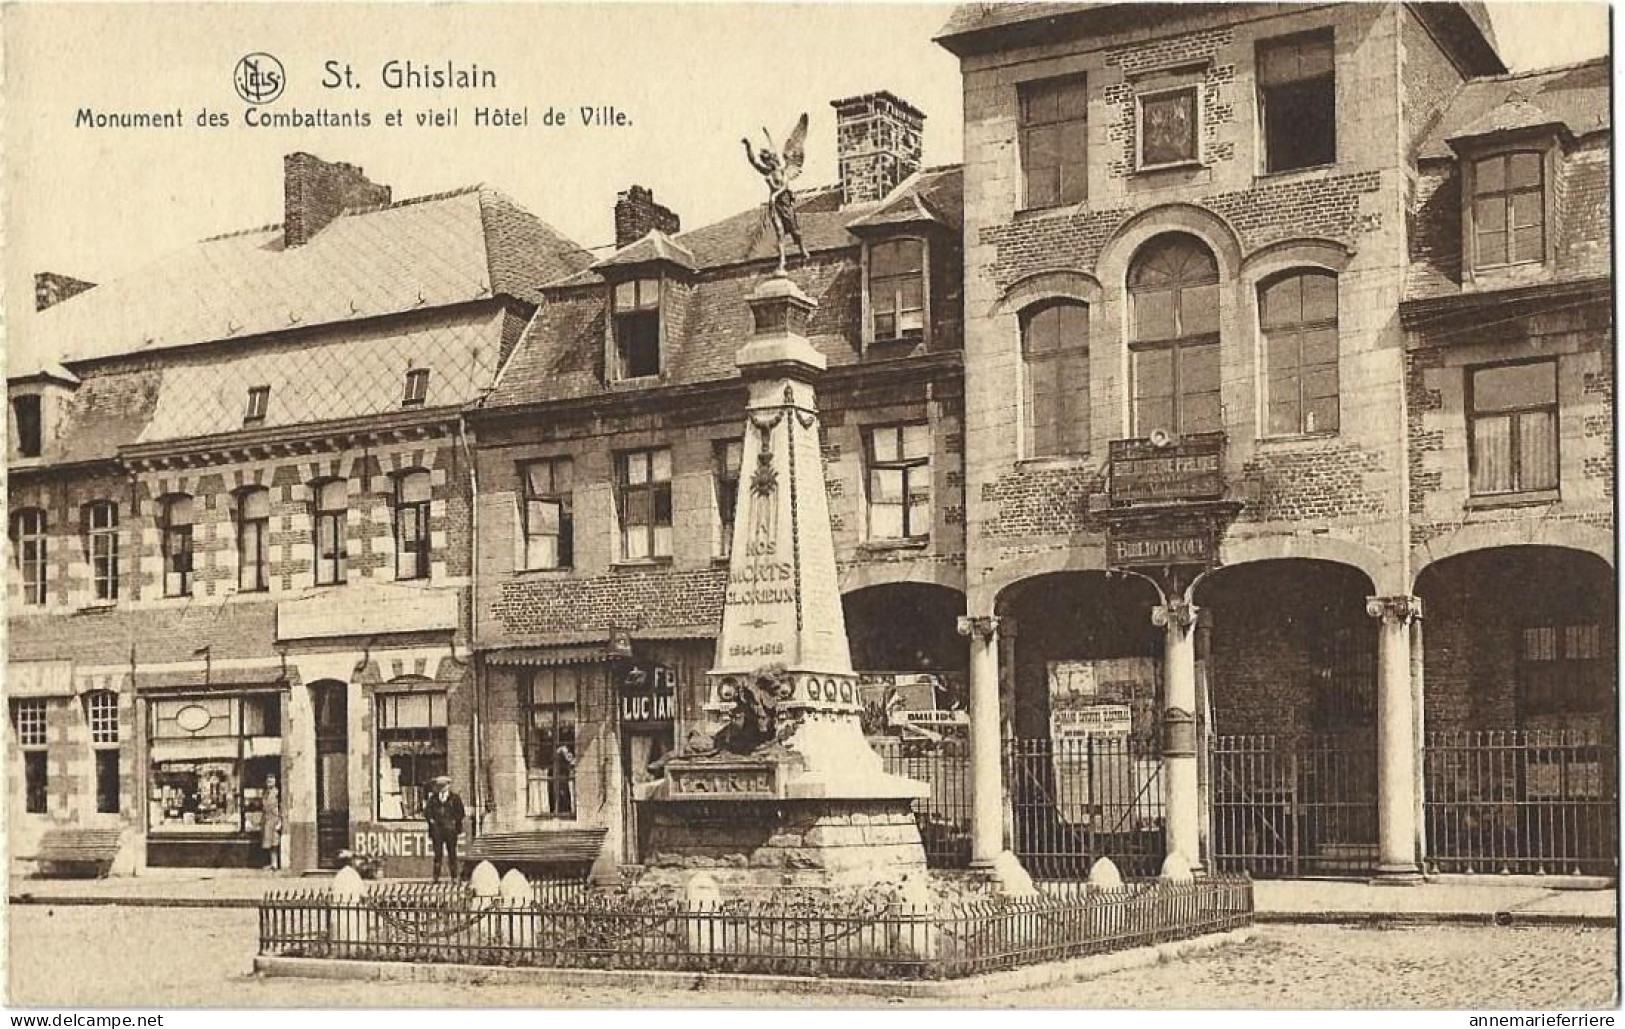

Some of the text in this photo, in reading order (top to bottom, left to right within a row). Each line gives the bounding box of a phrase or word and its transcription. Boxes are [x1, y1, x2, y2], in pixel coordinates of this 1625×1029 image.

[745, 540, 777, 557] NOS
[728, 562, 792, 584] MORTS
[726, 588, 794, 606] GLORIEUX
[355, 831, 467, 857] BONNETEE
